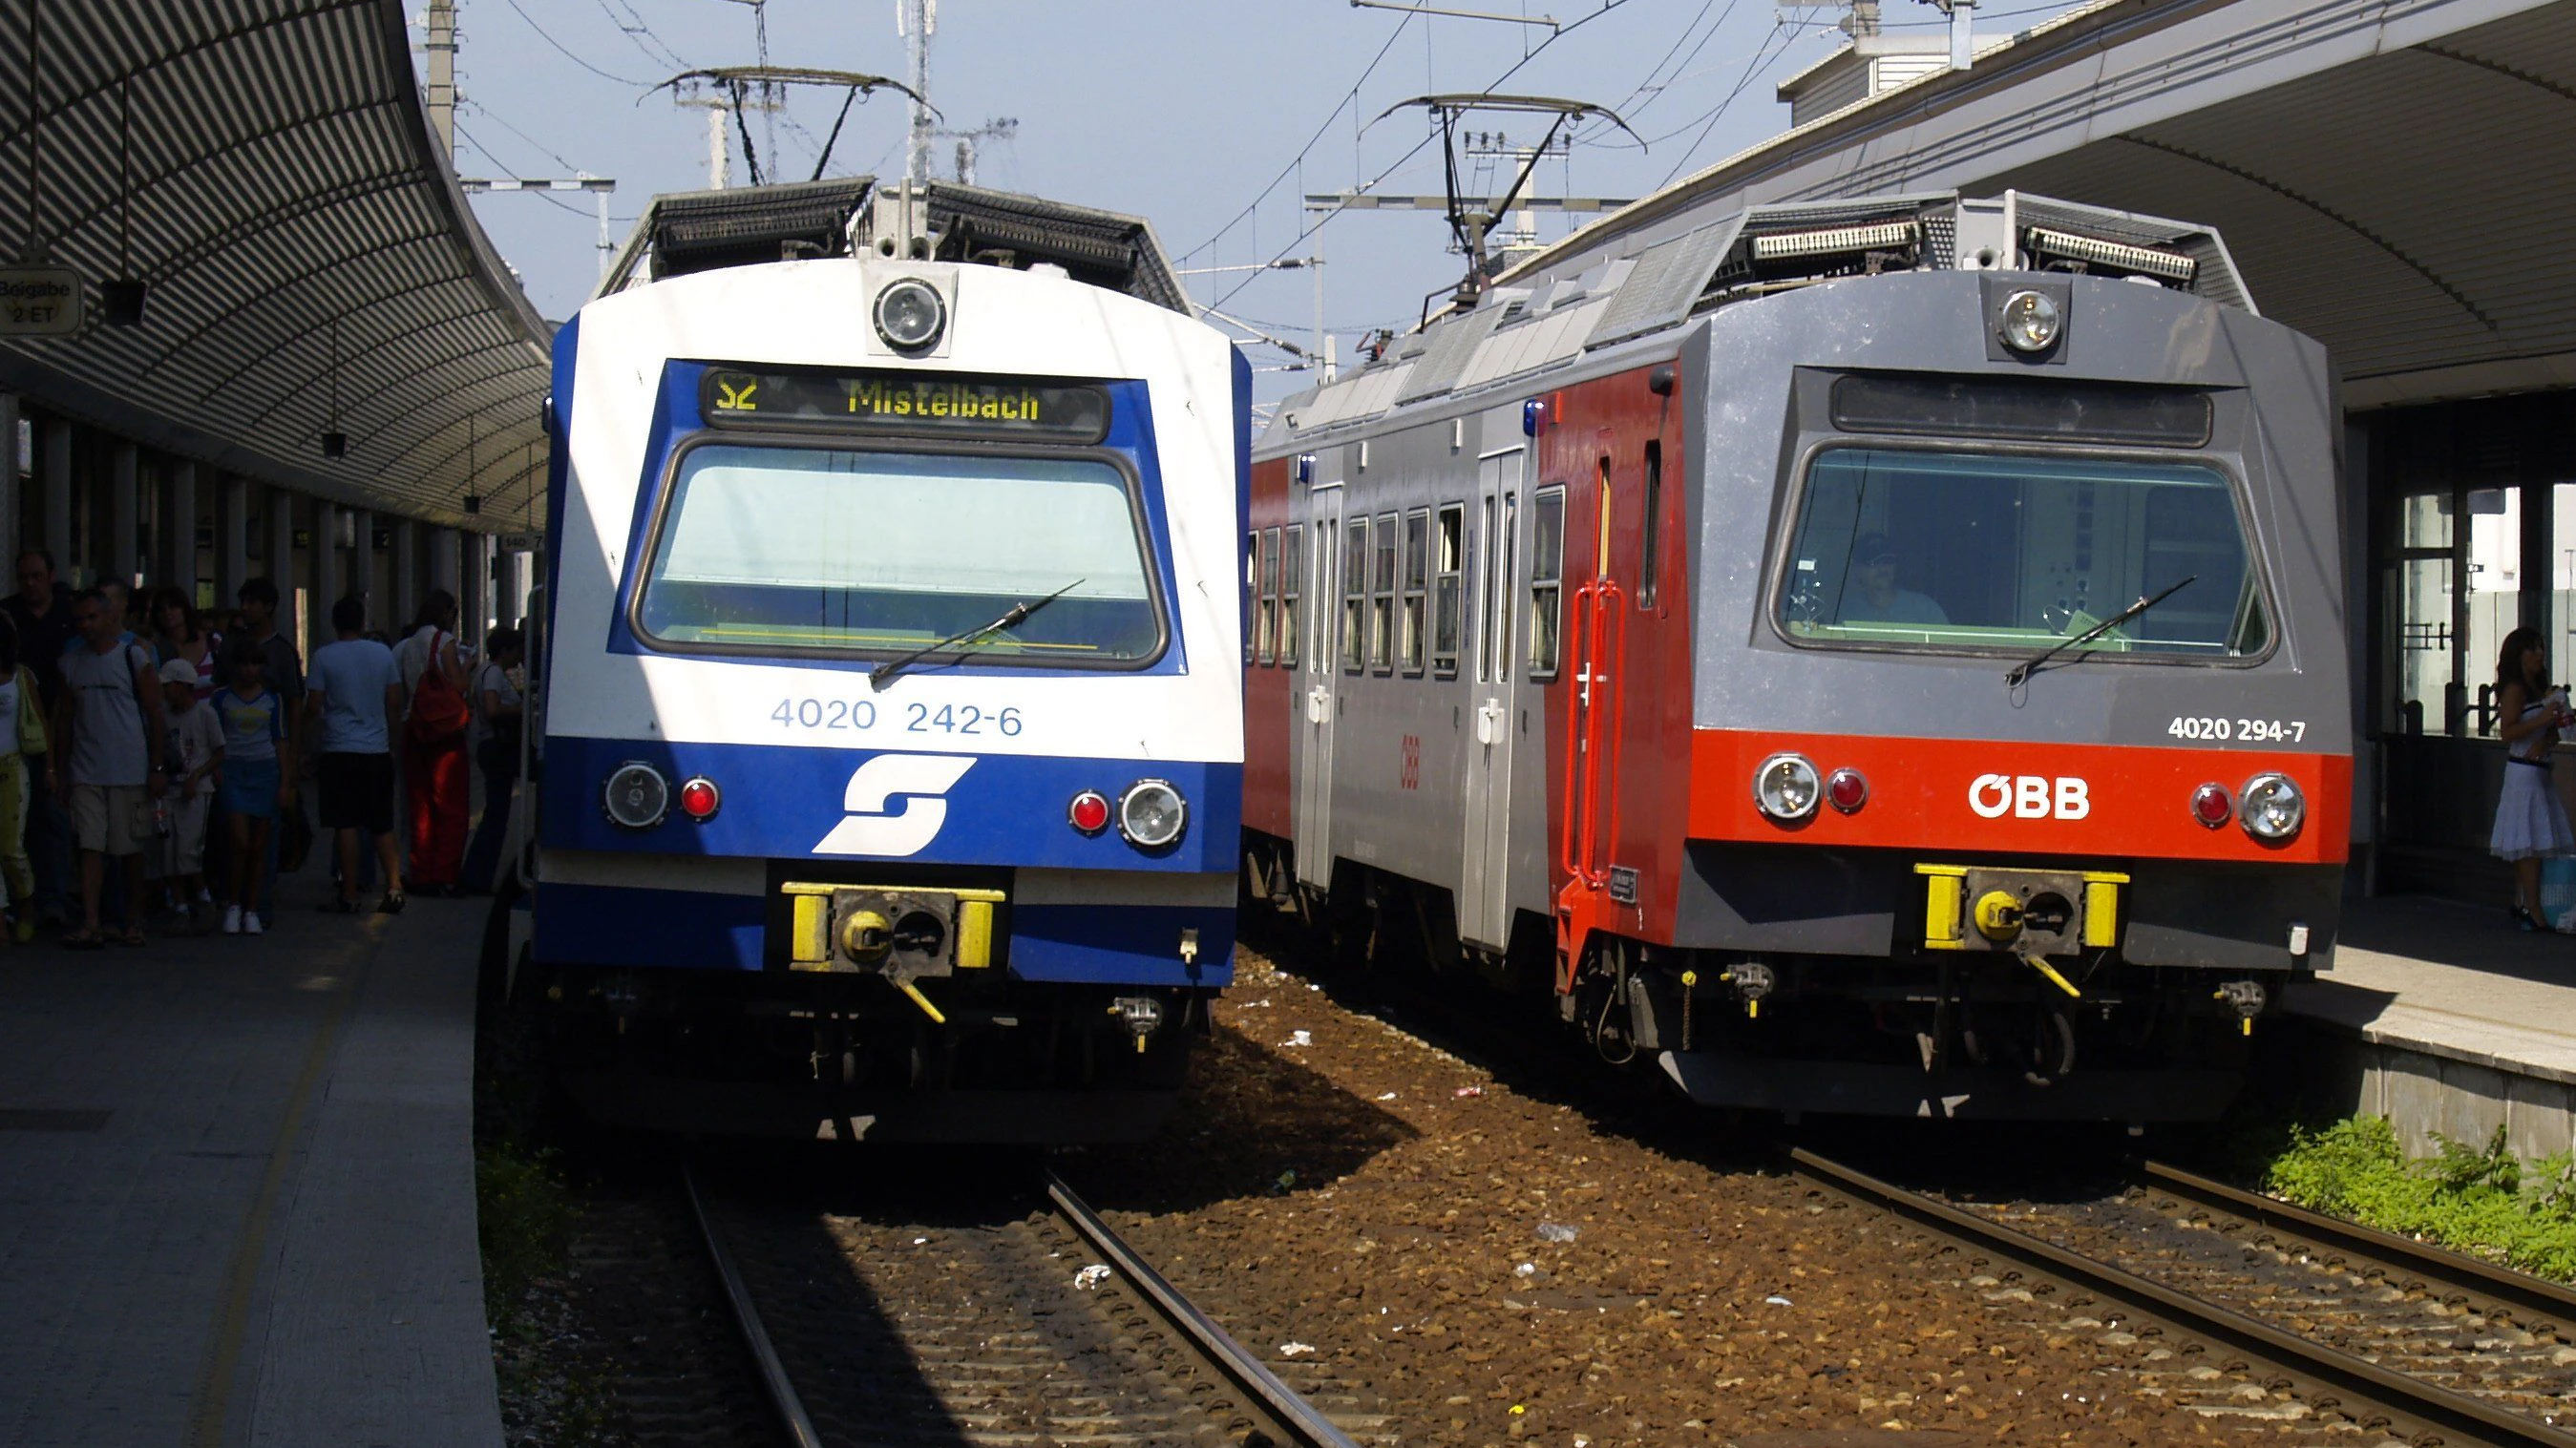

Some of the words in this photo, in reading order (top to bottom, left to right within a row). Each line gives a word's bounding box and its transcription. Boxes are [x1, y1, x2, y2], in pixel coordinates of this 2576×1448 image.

[13, 307, 24, 323] 2
[31, 306, 54, 323] ET
[716, 375, 757, 410] S2
[848, 378, 1039, 421] Mistelbach
[771, 699, 876, 730] 4020
[907, 703, 1023, 736] 242-6
[2168, 715, 2229, 741] 4020
[2237, 721, 2306, 743] 294-7
[1969, 773, 2090, 820] ÖBB
